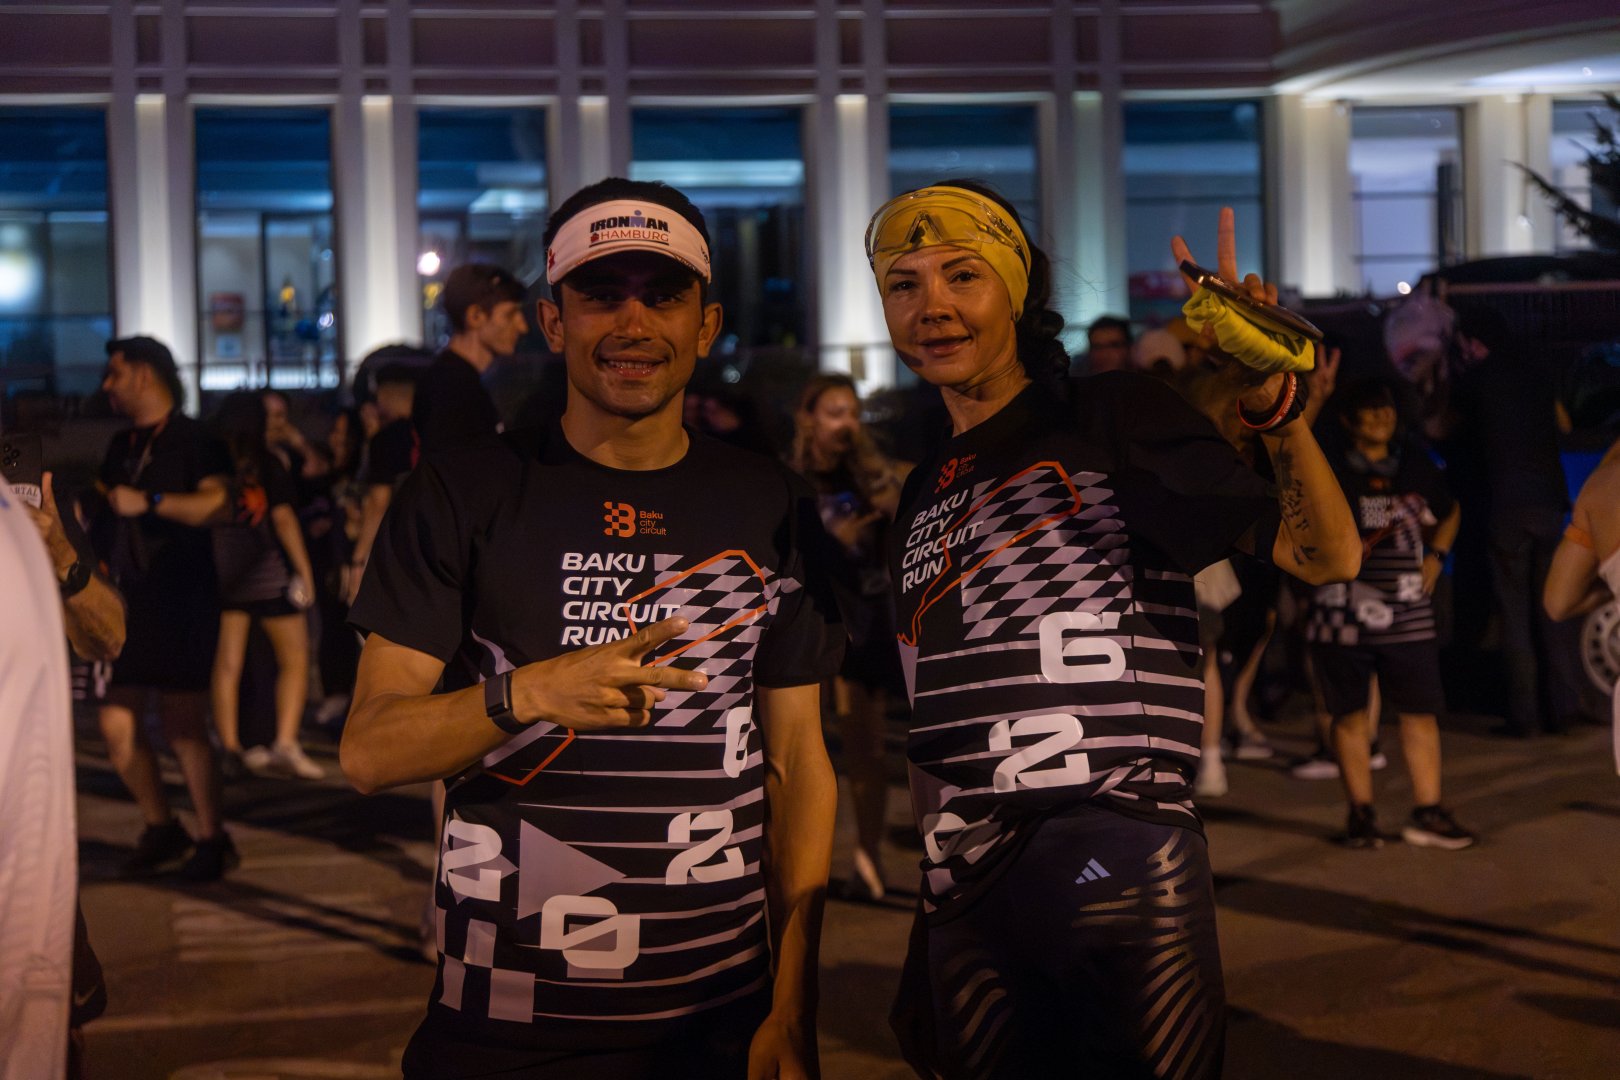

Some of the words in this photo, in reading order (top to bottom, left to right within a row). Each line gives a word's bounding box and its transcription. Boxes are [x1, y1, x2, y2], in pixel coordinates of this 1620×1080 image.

[590, 210, 669, 233] IRONMAN
[601, 229, 669, 242] HAMBURG
[639, 510, 664, 520] Baku
[911, 489, 968, 530] BAKU
[906, 513, 954, 548] CITY
[902, 520, 984, 569] CIRCUIT
[561, 552, 646, 573] BAKU
[562, 576, 633, 596] CITY
[902, 556, 944, 594] RUN
[562, 601, 681, 623] CIRCUIT
[561, 626, 631, 646] RUN
